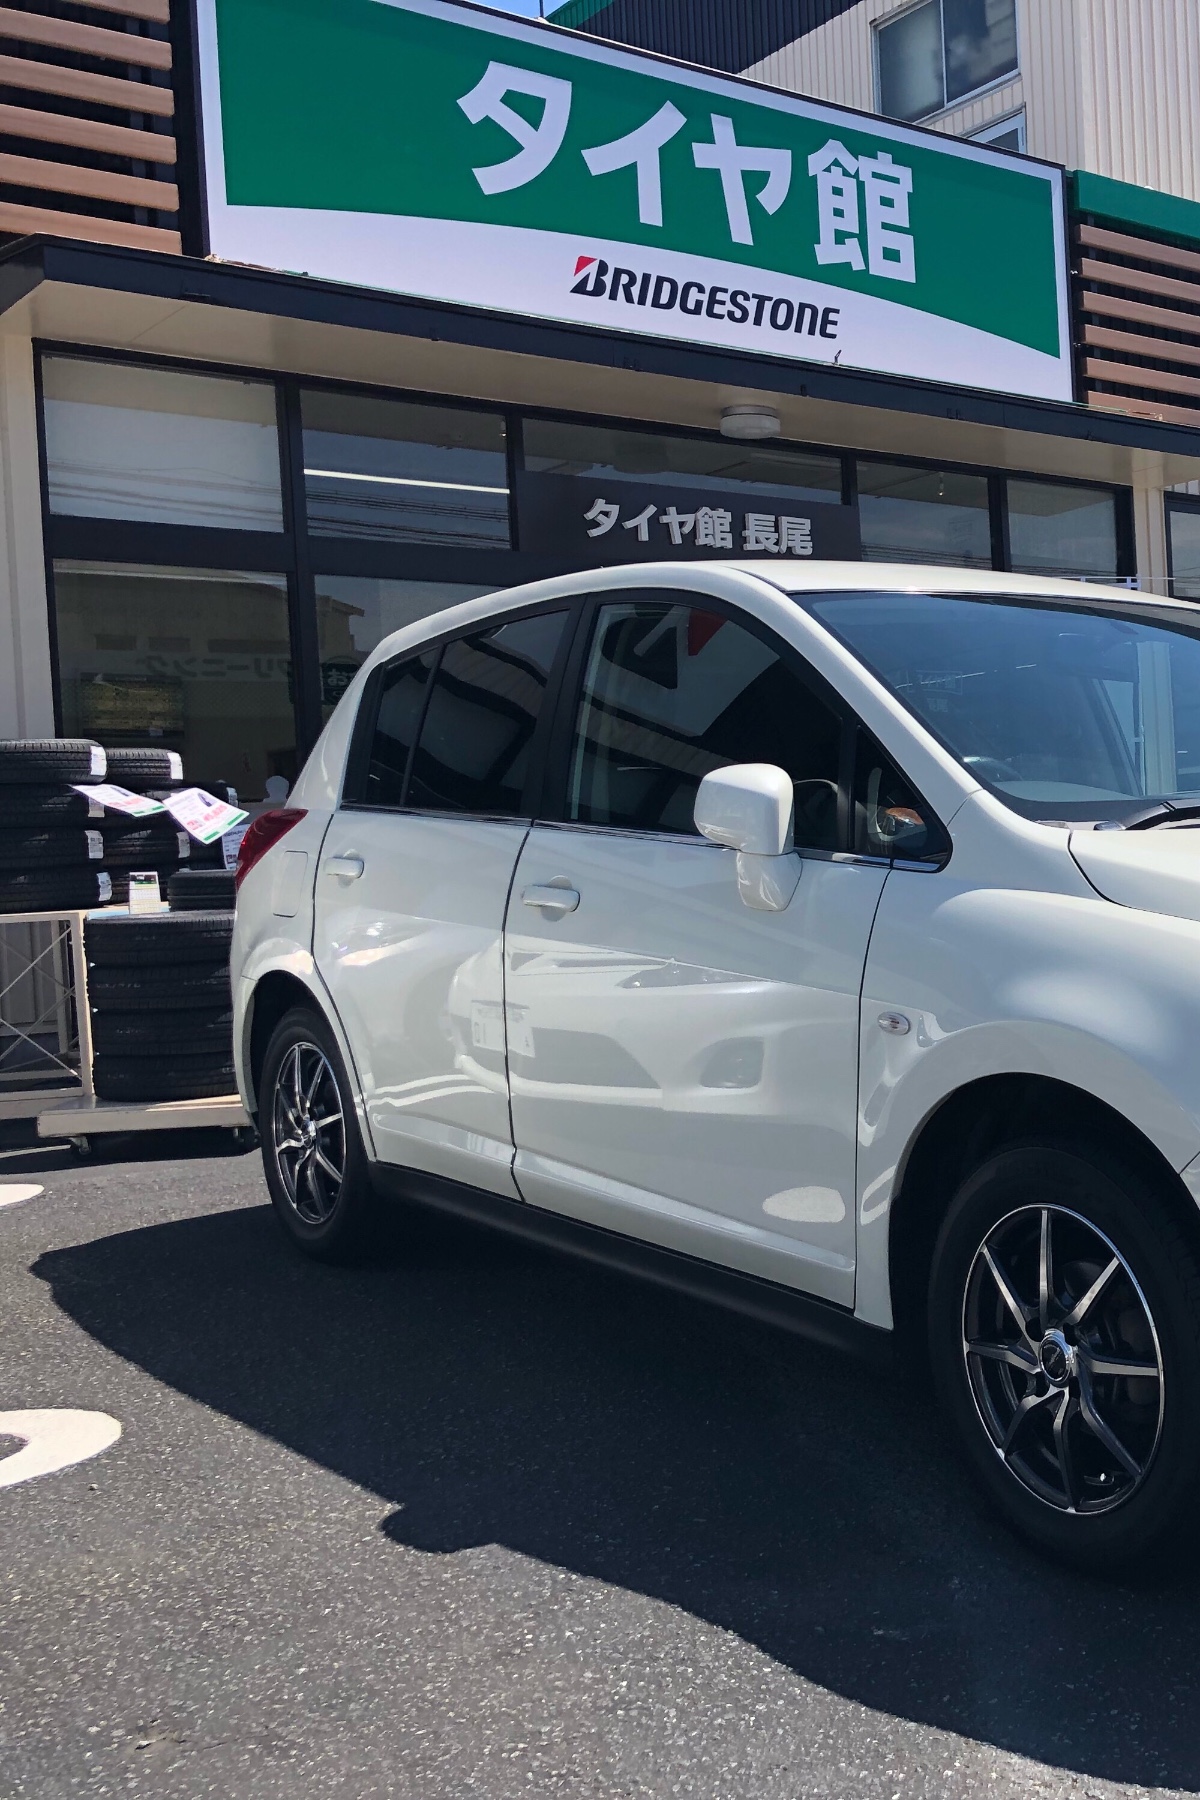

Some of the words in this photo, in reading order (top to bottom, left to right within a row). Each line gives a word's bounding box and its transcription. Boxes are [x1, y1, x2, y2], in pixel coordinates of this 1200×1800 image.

[457, 60, 916, 283] タイヤ館
[570, 256, 840, 339] BRIDGESTONE
[584, 498, 733, 549] タイヤ館
[742, 512, 813, 555] 長尾
